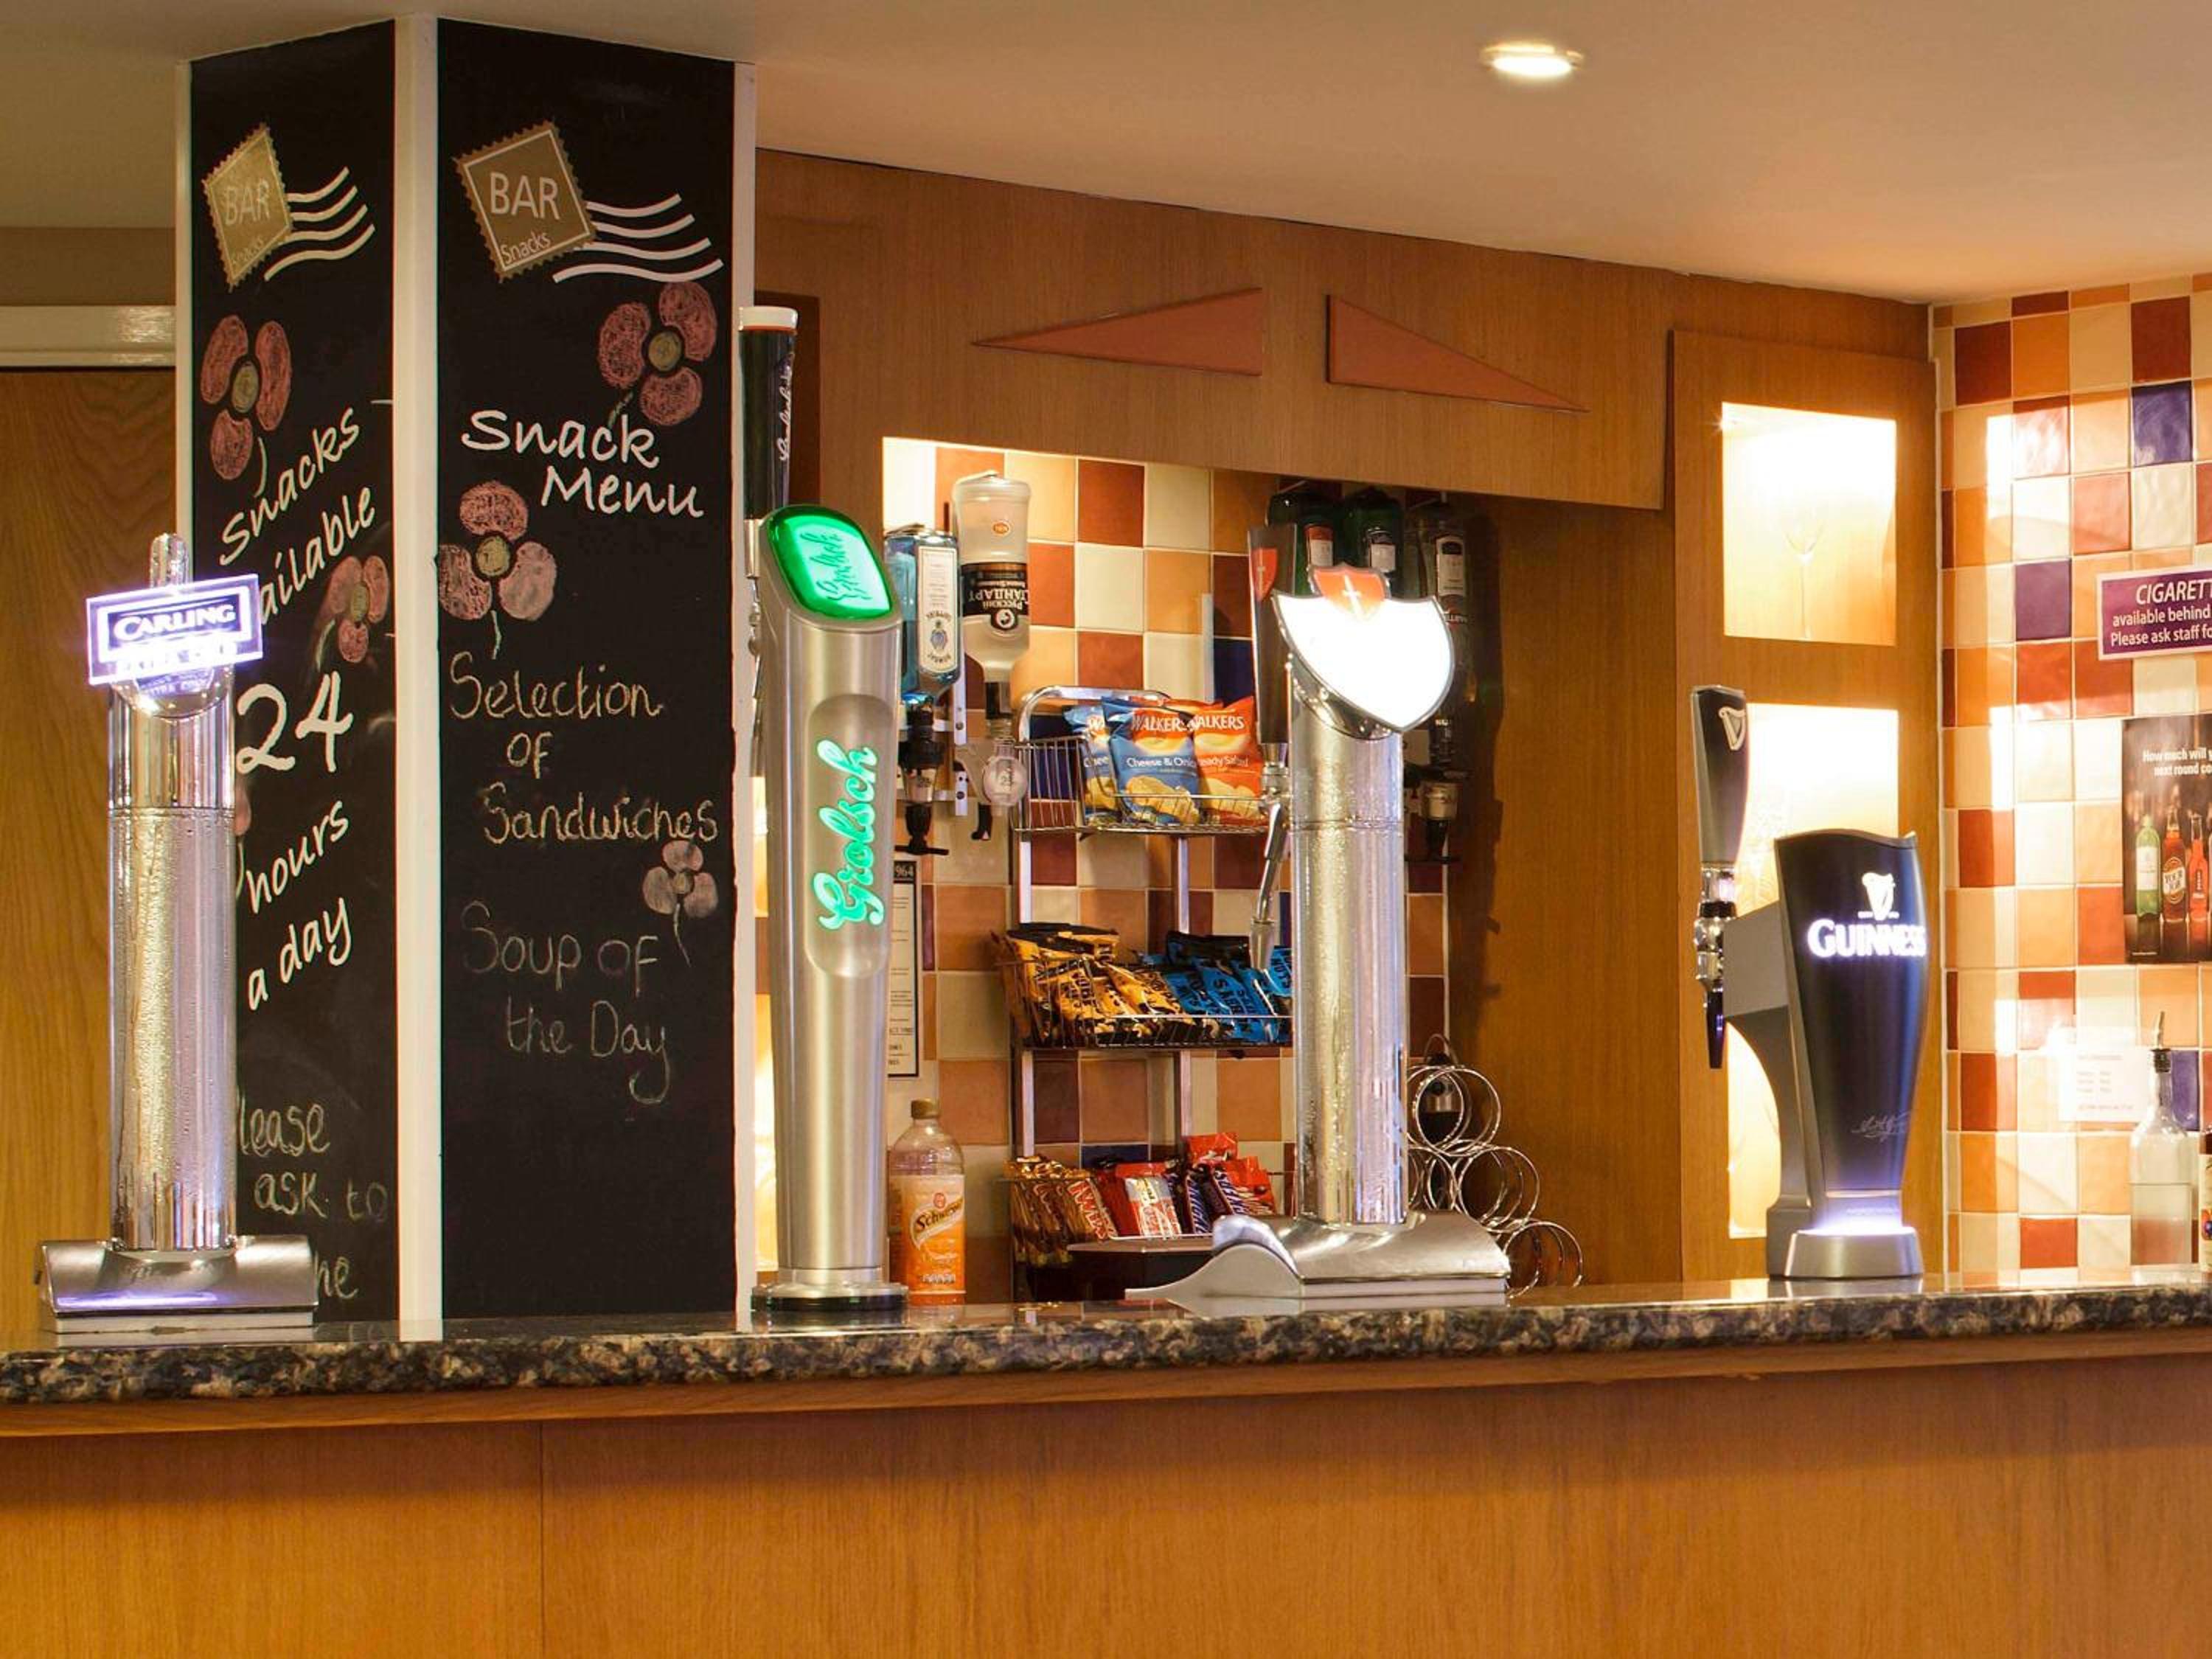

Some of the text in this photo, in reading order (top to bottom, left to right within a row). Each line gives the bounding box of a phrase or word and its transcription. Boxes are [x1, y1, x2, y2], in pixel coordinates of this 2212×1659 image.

[223, 178, 271, 226] BAR
[489, 171, 560, 220] BAR
[500, 232, 552, 266] Snacks
[460, 409, 661, 469] Snack
[219, 407, 360, 566] Snacks
[540, 465, 705, 519] Menu
[260, 487, 375, 625] ailable
[114, 603, 237, 641] CARLING
[2111, 631, 2149, 647] Please
[2151, 627, 2171, 643] ask
[2174, 624, 2200, 641] staff
[2112, 603, 2211, 627] available behind
[449, 651, 664, 721] Selection
[235, 669, 355, 773] 24
[482, 781, 719, 845] Sandwiches
[813, 739, 885, 931] Grolsch
[246, 800, 349, 914] hours
[248, 896, 352, 1011] a day
[461, 900, 582, 990] Soup
[507, 996, 672, 1105] the Day
[236, 1088, 330, 1158] lease
[347, 1180, 387, 1222] to
[315, 1251, 358, 1299] he
